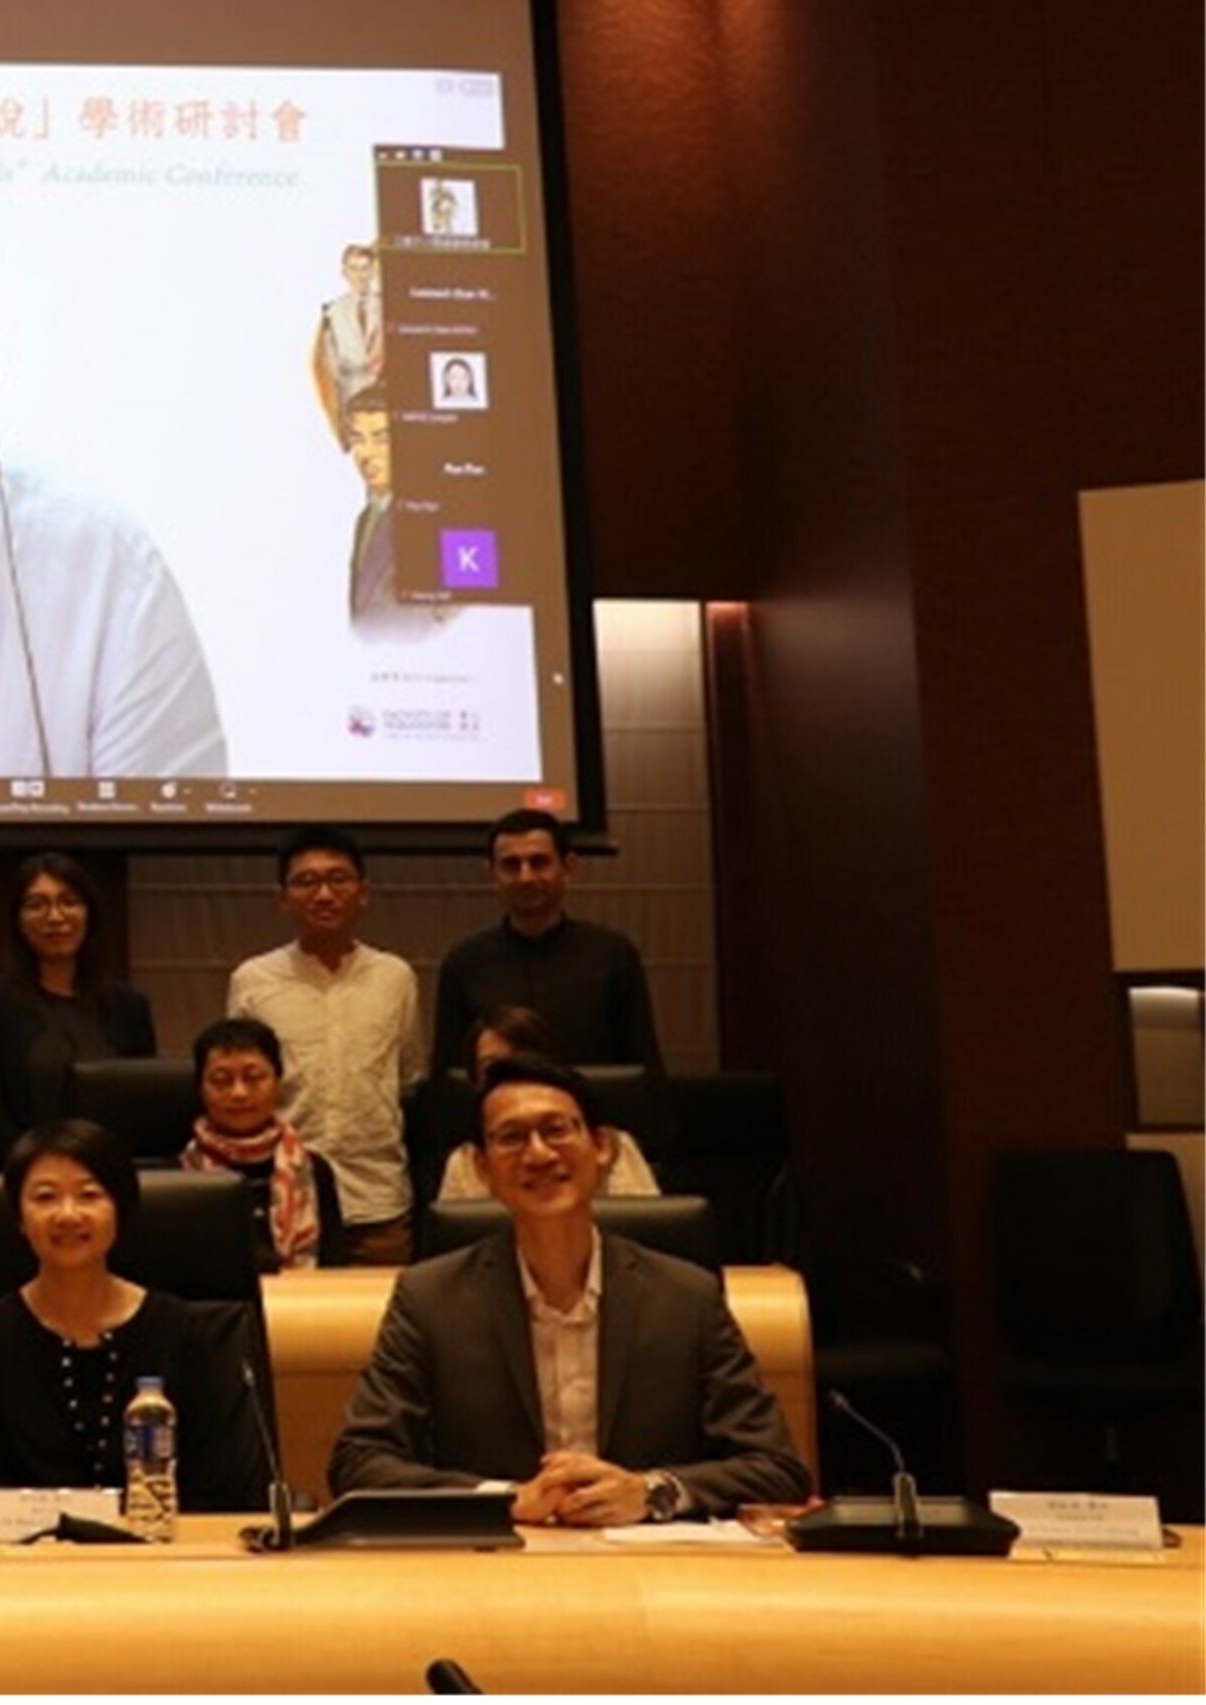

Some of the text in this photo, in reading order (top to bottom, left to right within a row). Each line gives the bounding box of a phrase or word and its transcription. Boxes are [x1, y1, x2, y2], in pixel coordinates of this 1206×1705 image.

[41, 162, 155, 187] Academic
[164, 164, 300, 189] Conference
[457, 546, 481, 572] K
